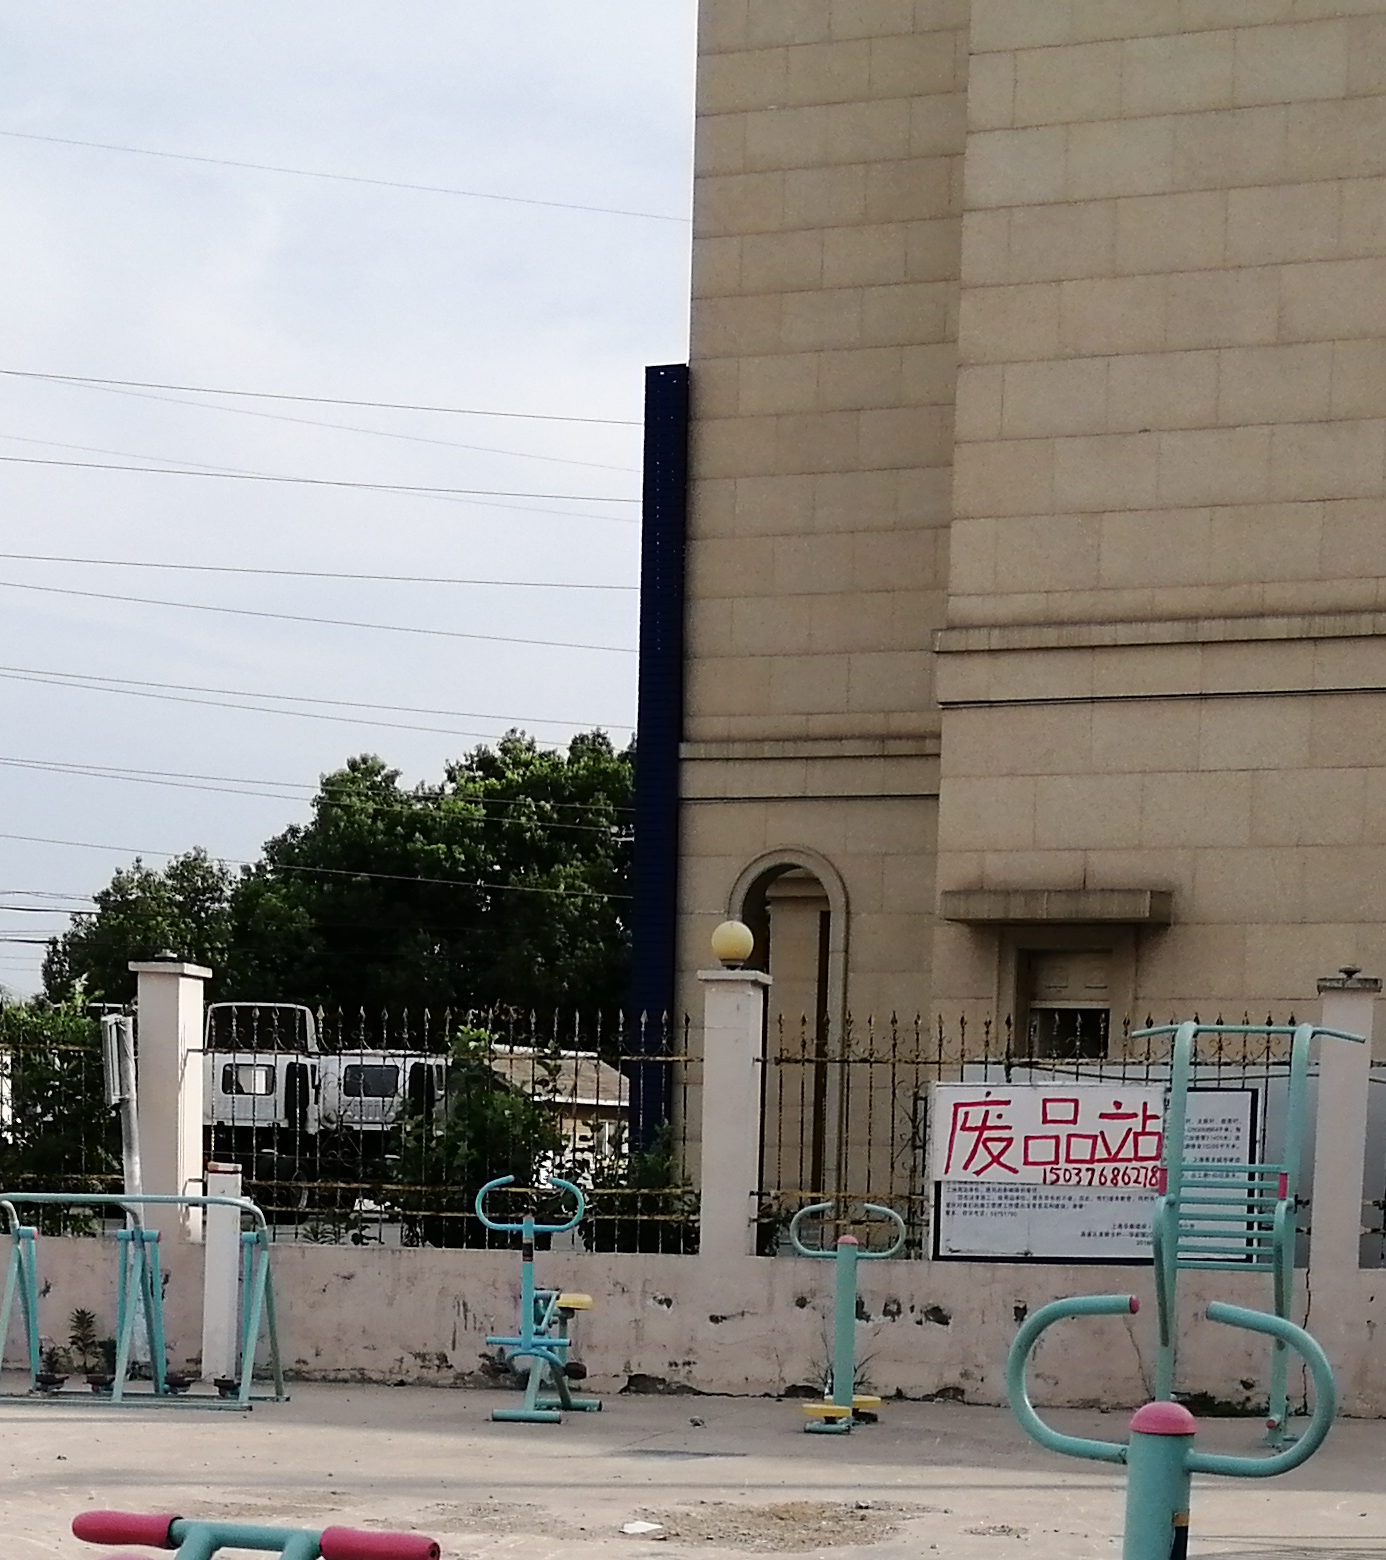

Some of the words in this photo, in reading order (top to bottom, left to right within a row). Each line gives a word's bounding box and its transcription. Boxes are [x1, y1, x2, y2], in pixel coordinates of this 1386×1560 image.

[944, 1091, 1162, 1176] 废品站
[1042, 1165, 1159, 1186] 15037686278
